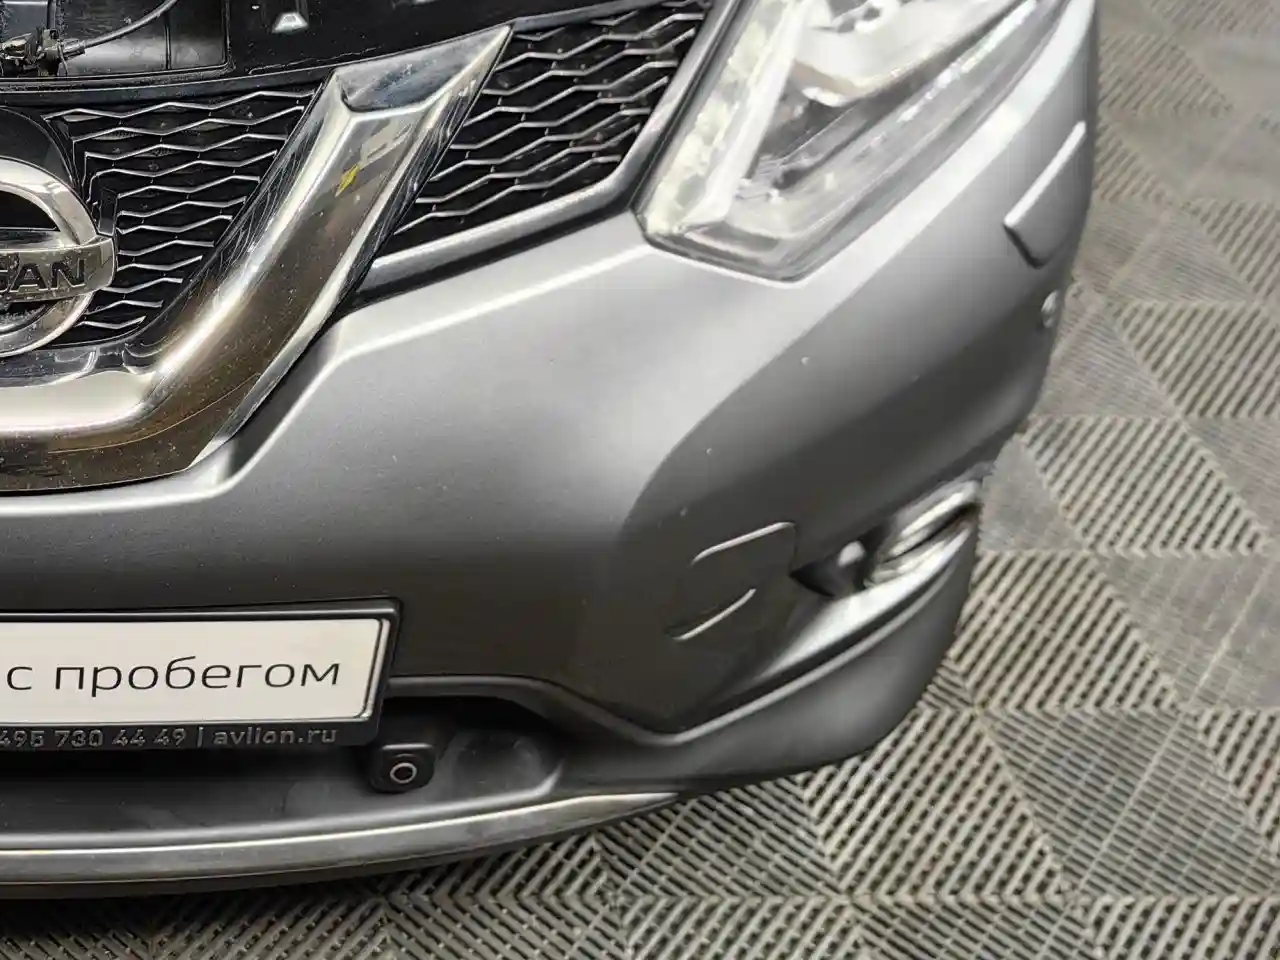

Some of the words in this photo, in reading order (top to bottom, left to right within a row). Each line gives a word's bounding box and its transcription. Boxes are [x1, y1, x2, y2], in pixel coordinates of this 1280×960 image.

[6, 665, 32, 690] с
[55, 655, 340, 697] пробегом
[54, 729, 103, 747] 730
[112, 728, 146, 747] 44
[153, 728, 187, 746] 49
